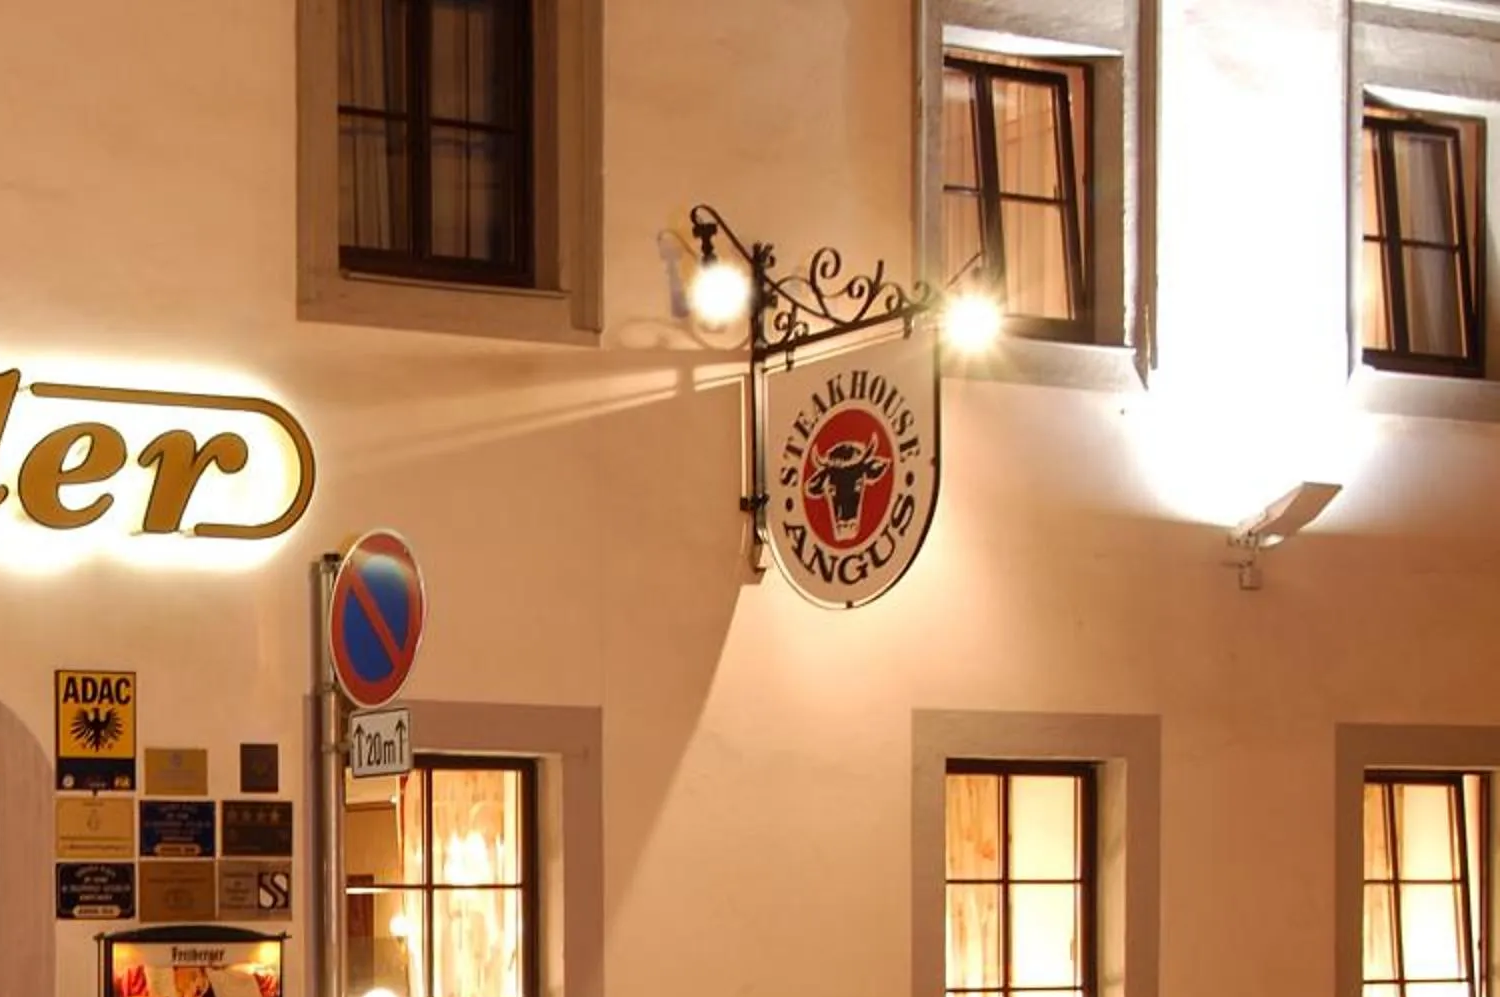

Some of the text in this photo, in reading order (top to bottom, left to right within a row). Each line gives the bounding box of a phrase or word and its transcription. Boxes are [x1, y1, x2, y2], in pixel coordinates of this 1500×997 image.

[780, 370, 920, 487] STEAKHOUSE
[782, 493, 916, 585] ANGUS
[63, 676, 132, 705] ADAC
